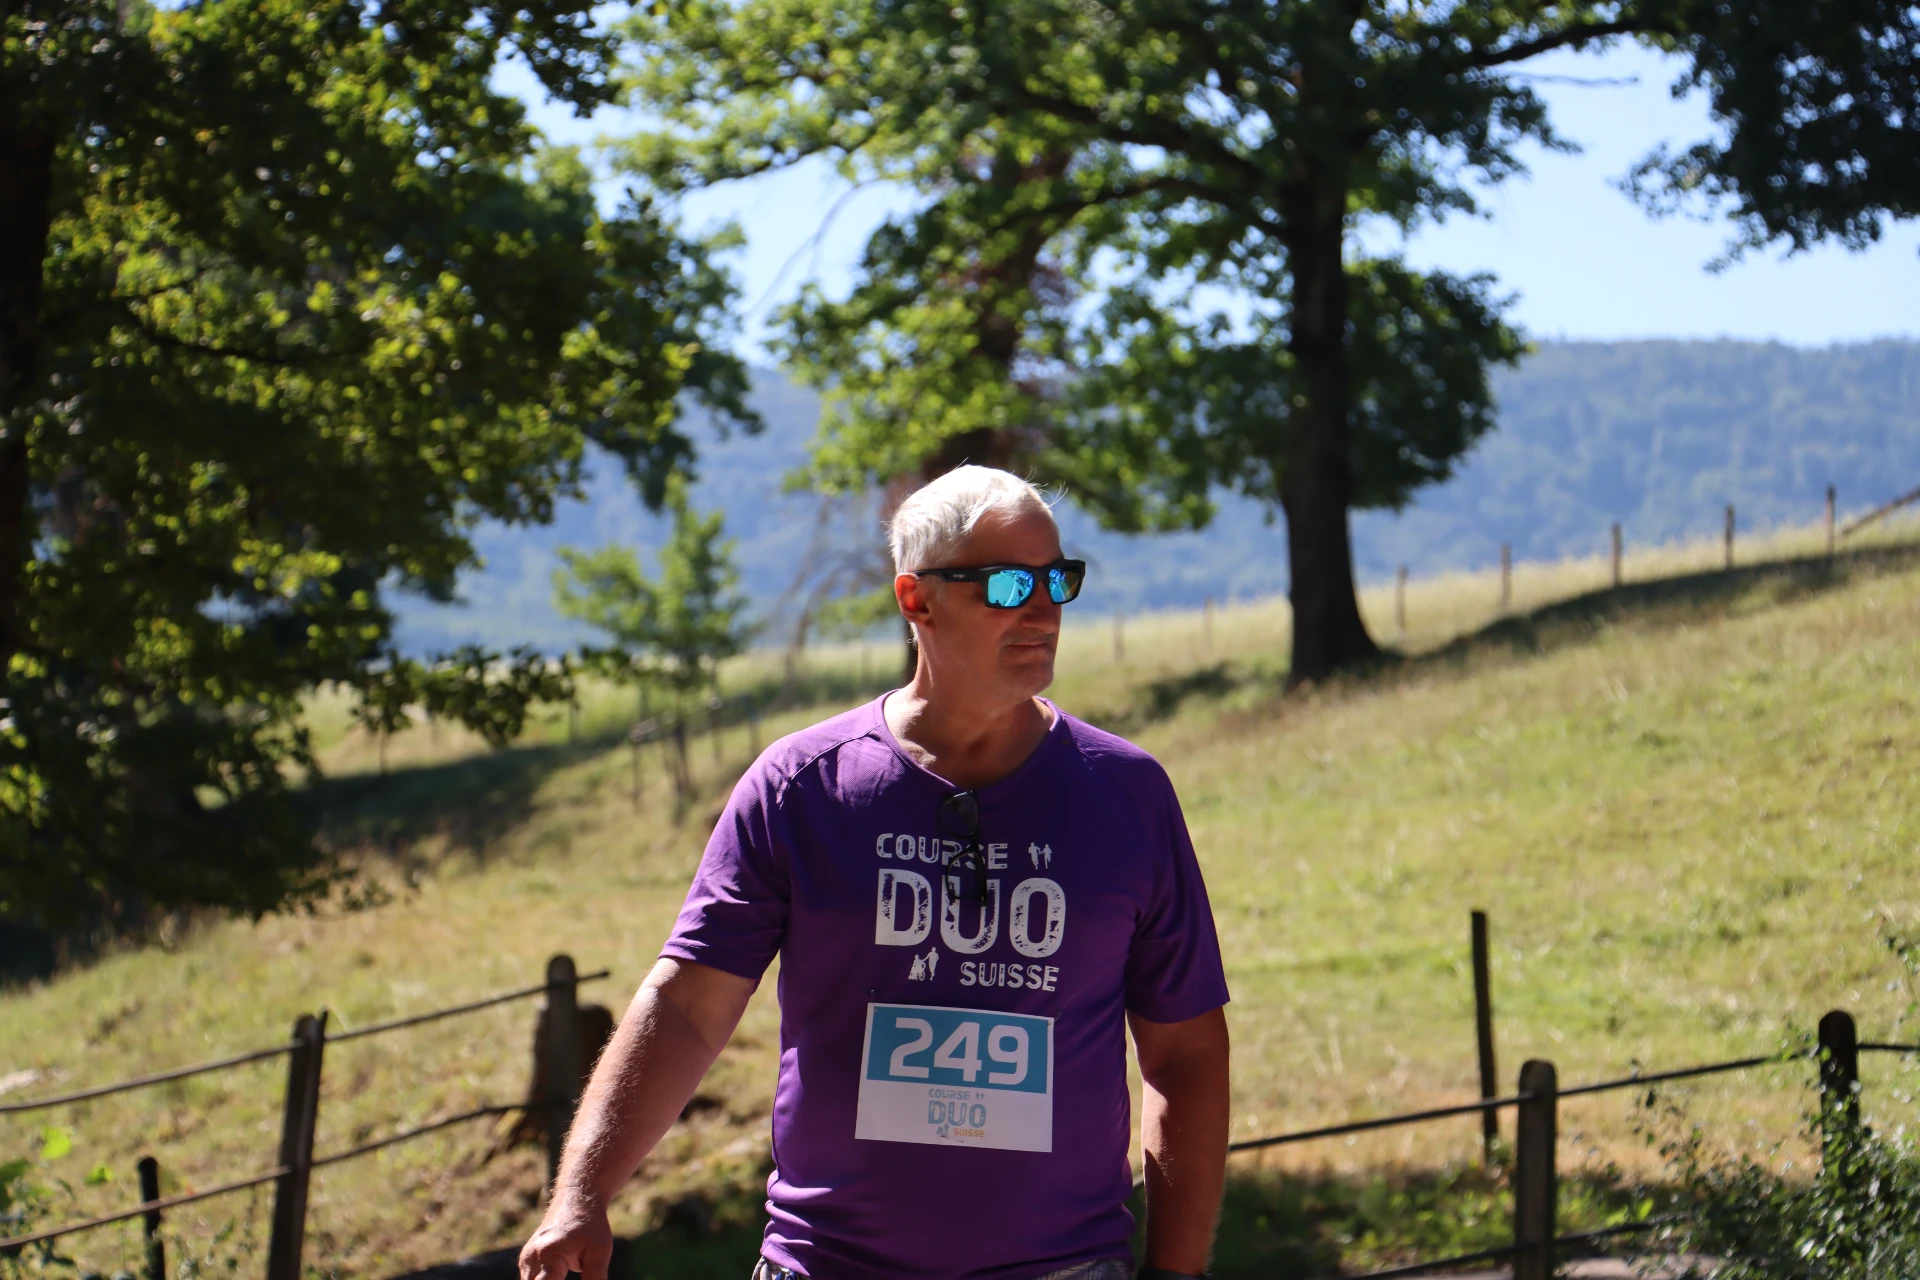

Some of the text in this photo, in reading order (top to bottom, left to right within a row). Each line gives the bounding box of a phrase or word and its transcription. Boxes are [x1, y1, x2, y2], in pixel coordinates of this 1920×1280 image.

[875, 868, 1066, 958] DUO
[960, 961, 1060, 992] SUISSE
[889, 1017, 1029, 1085] 249
[928, 1088, 971, 1100] COURSE
[927, 1100, 987, 1128] DUO
[953, 1128, 985, 1138] SUISSE
